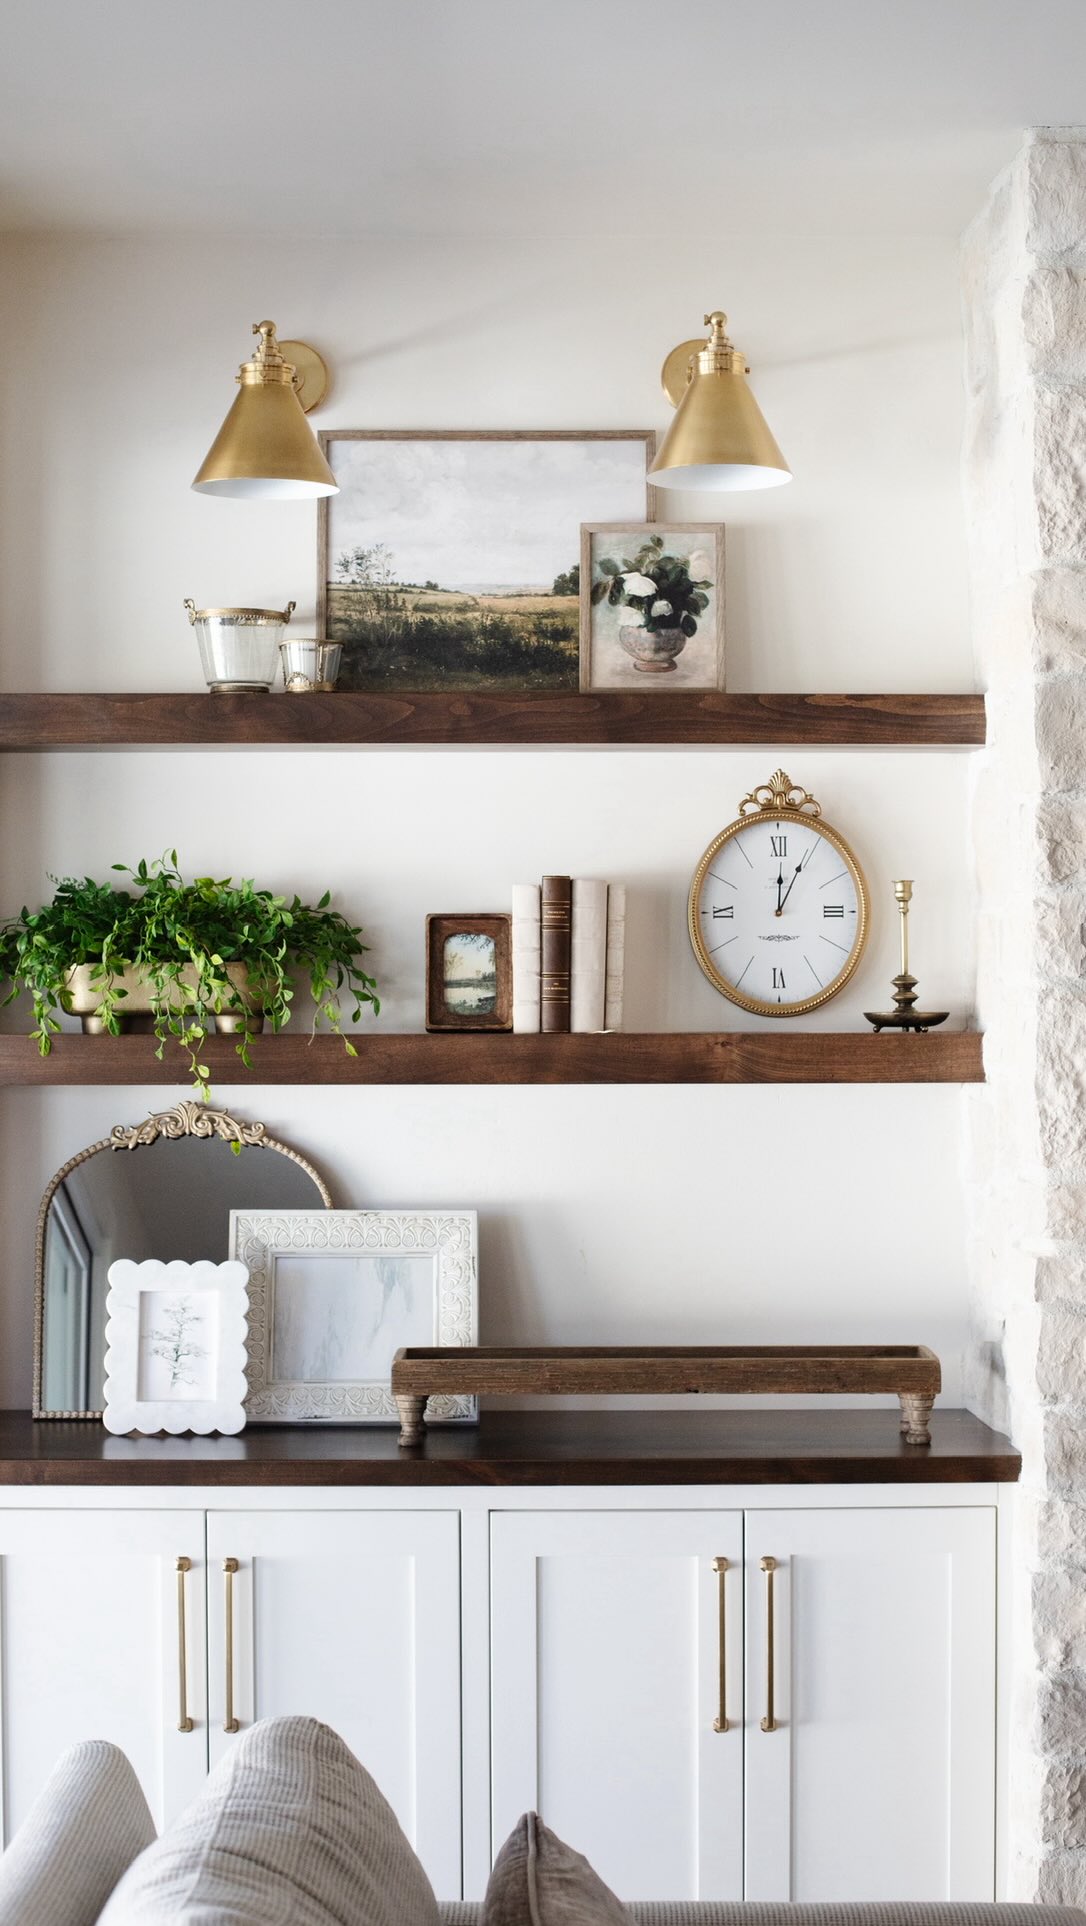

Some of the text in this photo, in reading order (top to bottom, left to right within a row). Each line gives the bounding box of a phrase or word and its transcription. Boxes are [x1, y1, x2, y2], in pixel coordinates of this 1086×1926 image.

[770, 836, 787, 857] XII
[713, 905, 734, 919] IX
[823, 905, 844, 918] III
[772, 967, 786, 989] VI
